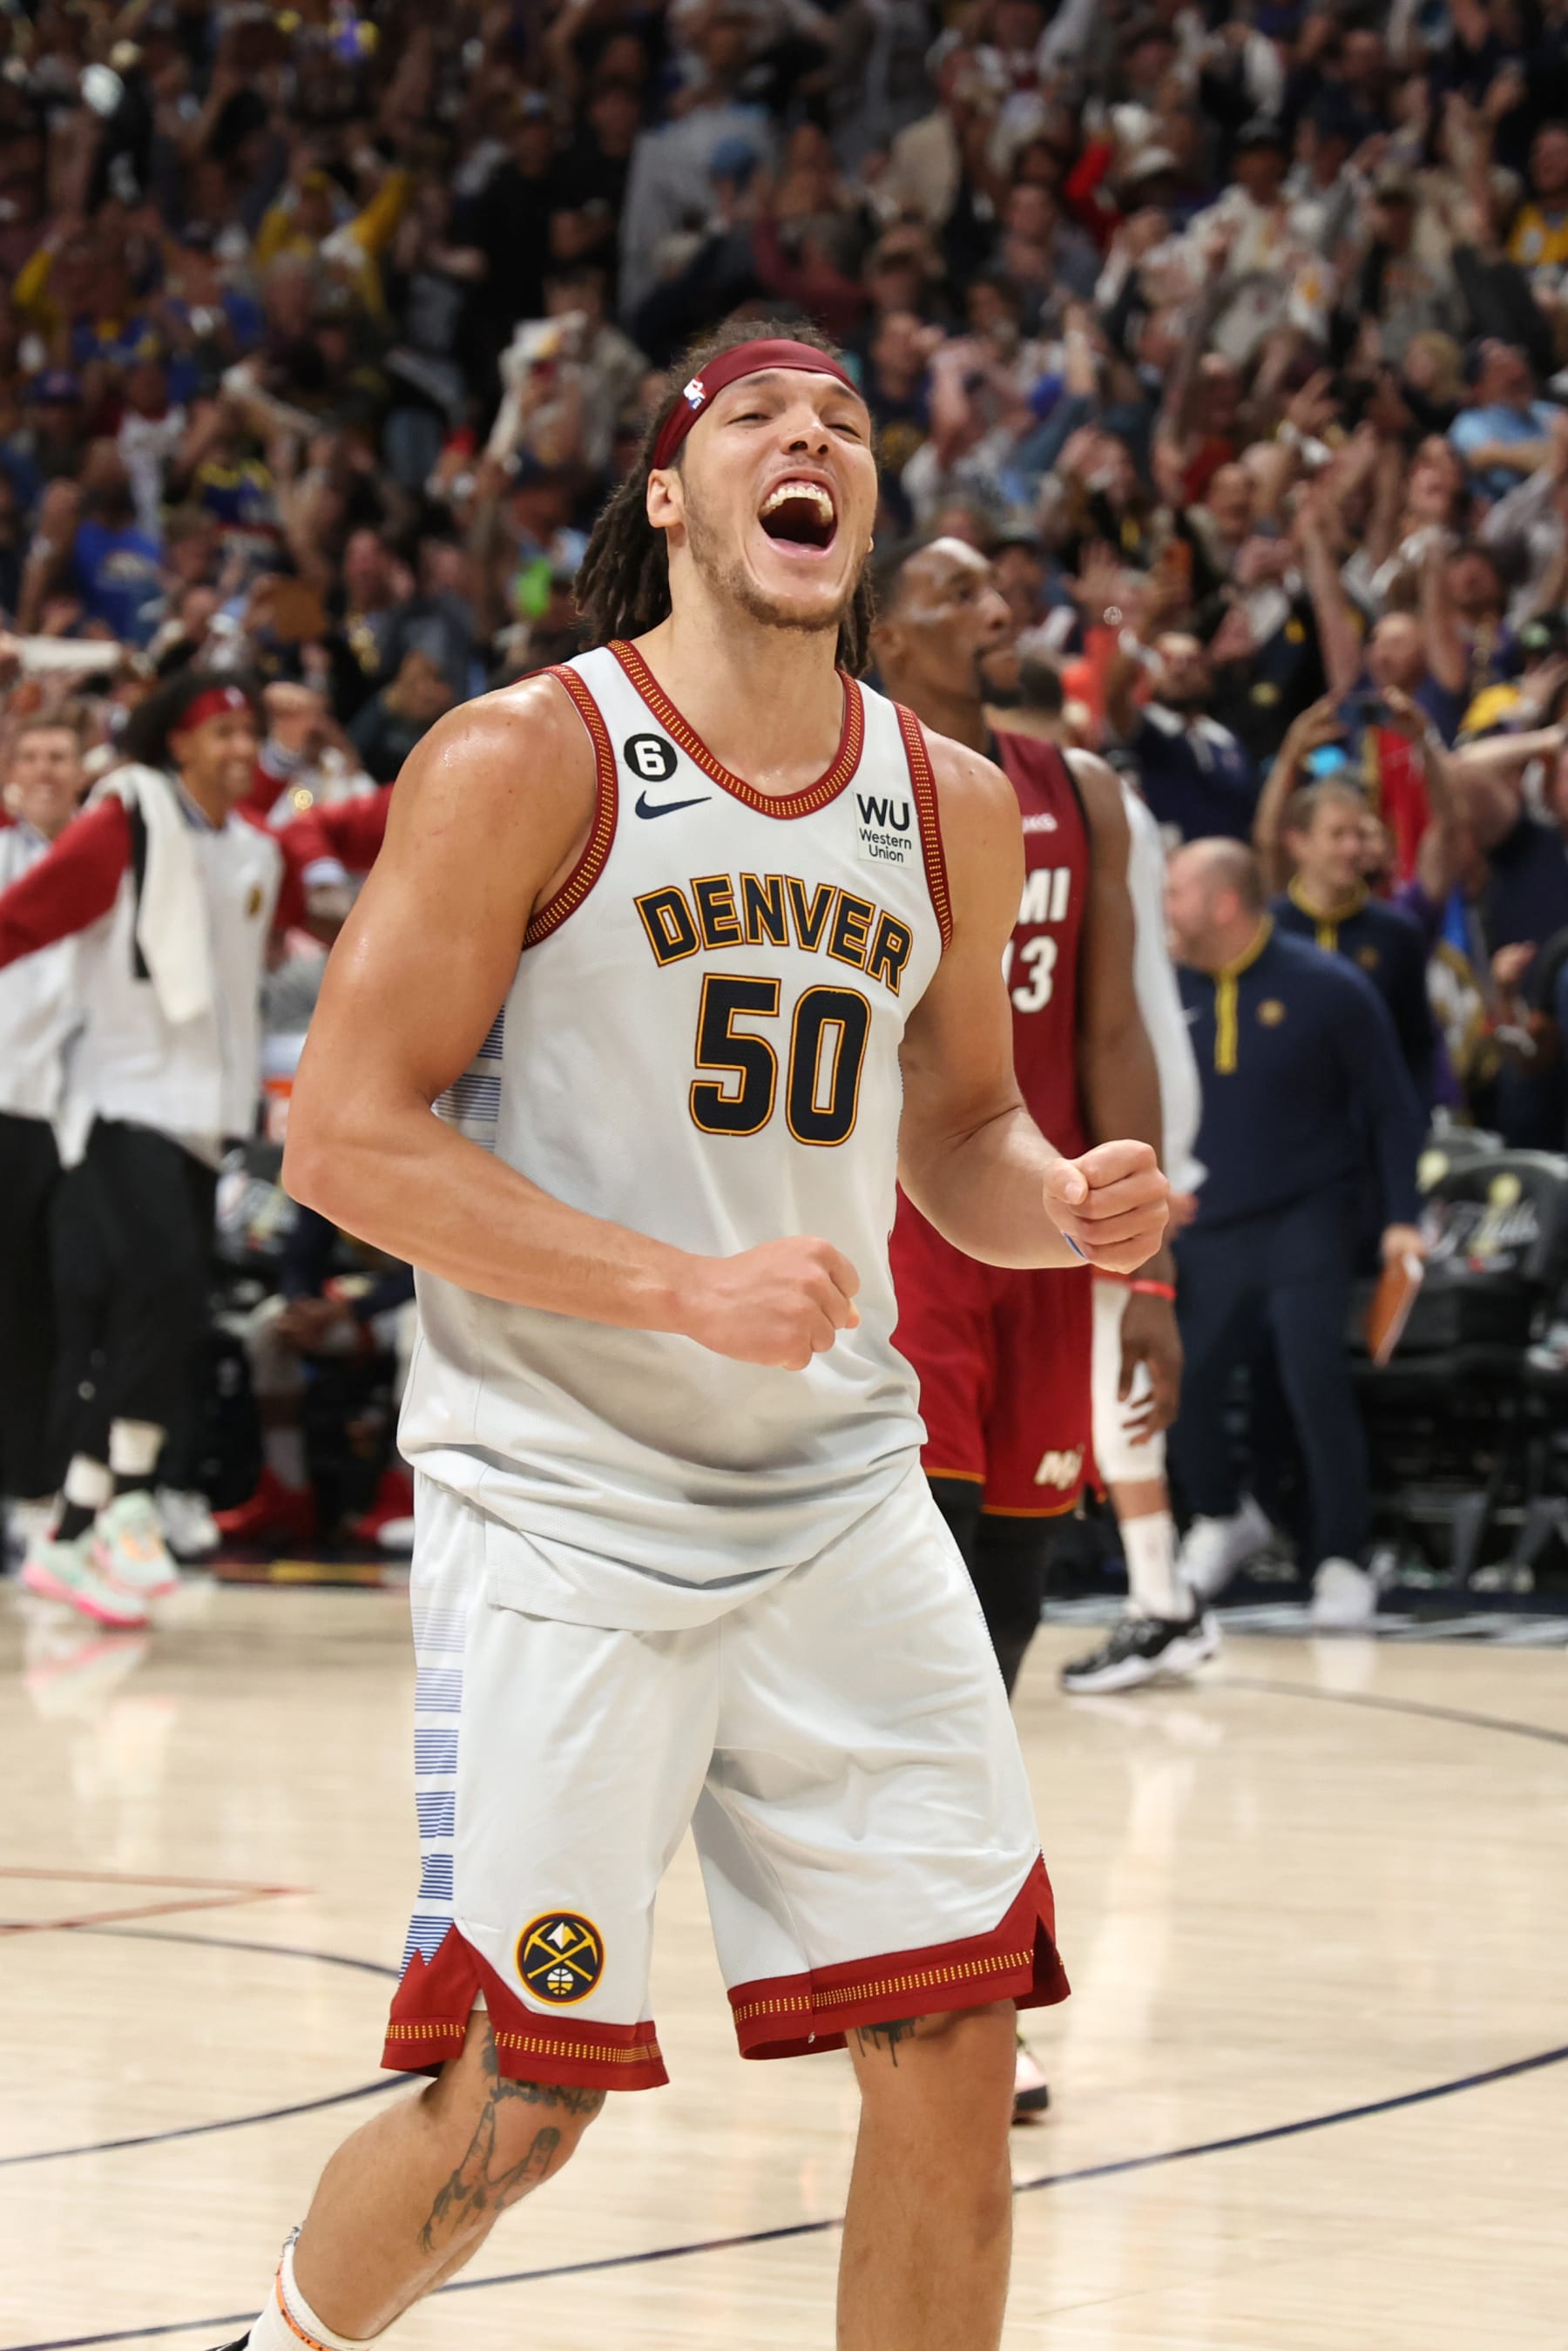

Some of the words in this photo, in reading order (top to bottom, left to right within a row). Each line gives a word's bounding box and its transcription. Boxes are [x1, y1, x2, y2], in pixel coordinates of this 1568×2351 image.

[633, 740, 666, 776] 6
[856, 793, 910, 832] WU
[859, 827, 912, 850] Western
[868, 843, 904, 863] Union
[632, 871, 914, 998] DENVER
[688, 972, 872, 1148] 50
